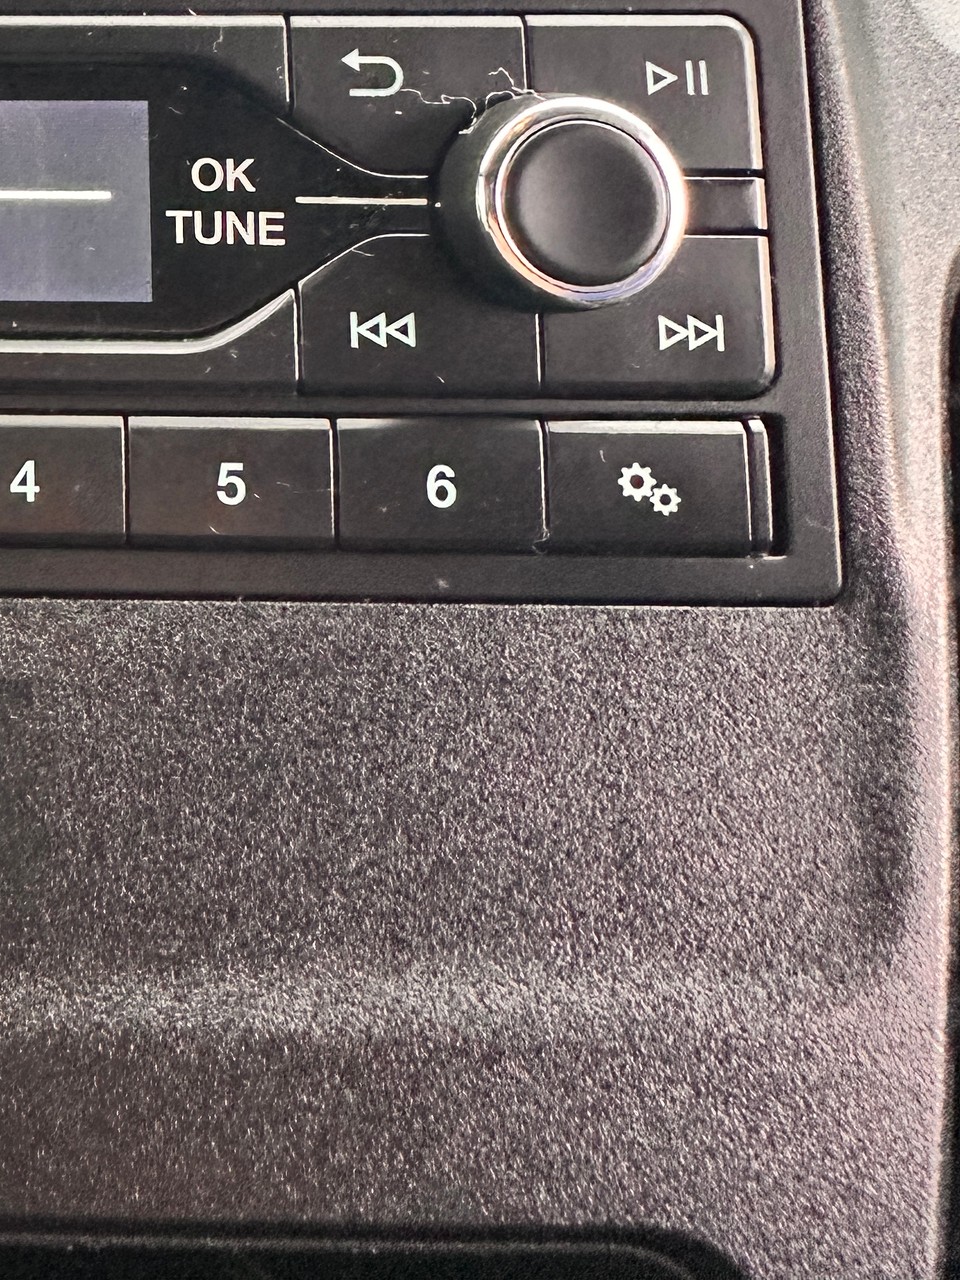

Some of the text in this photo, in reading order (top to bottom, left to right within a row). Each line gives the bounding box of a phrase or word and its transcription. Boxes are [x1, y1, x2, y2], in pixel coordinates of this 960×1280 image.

[190, 157, 257, 194] OK
[165, 210, 286, 247] TUNE
[9, 460, 41, 503] 4
[216, 462, 246, 506] 5
[426, 464, 457, 509] 6
